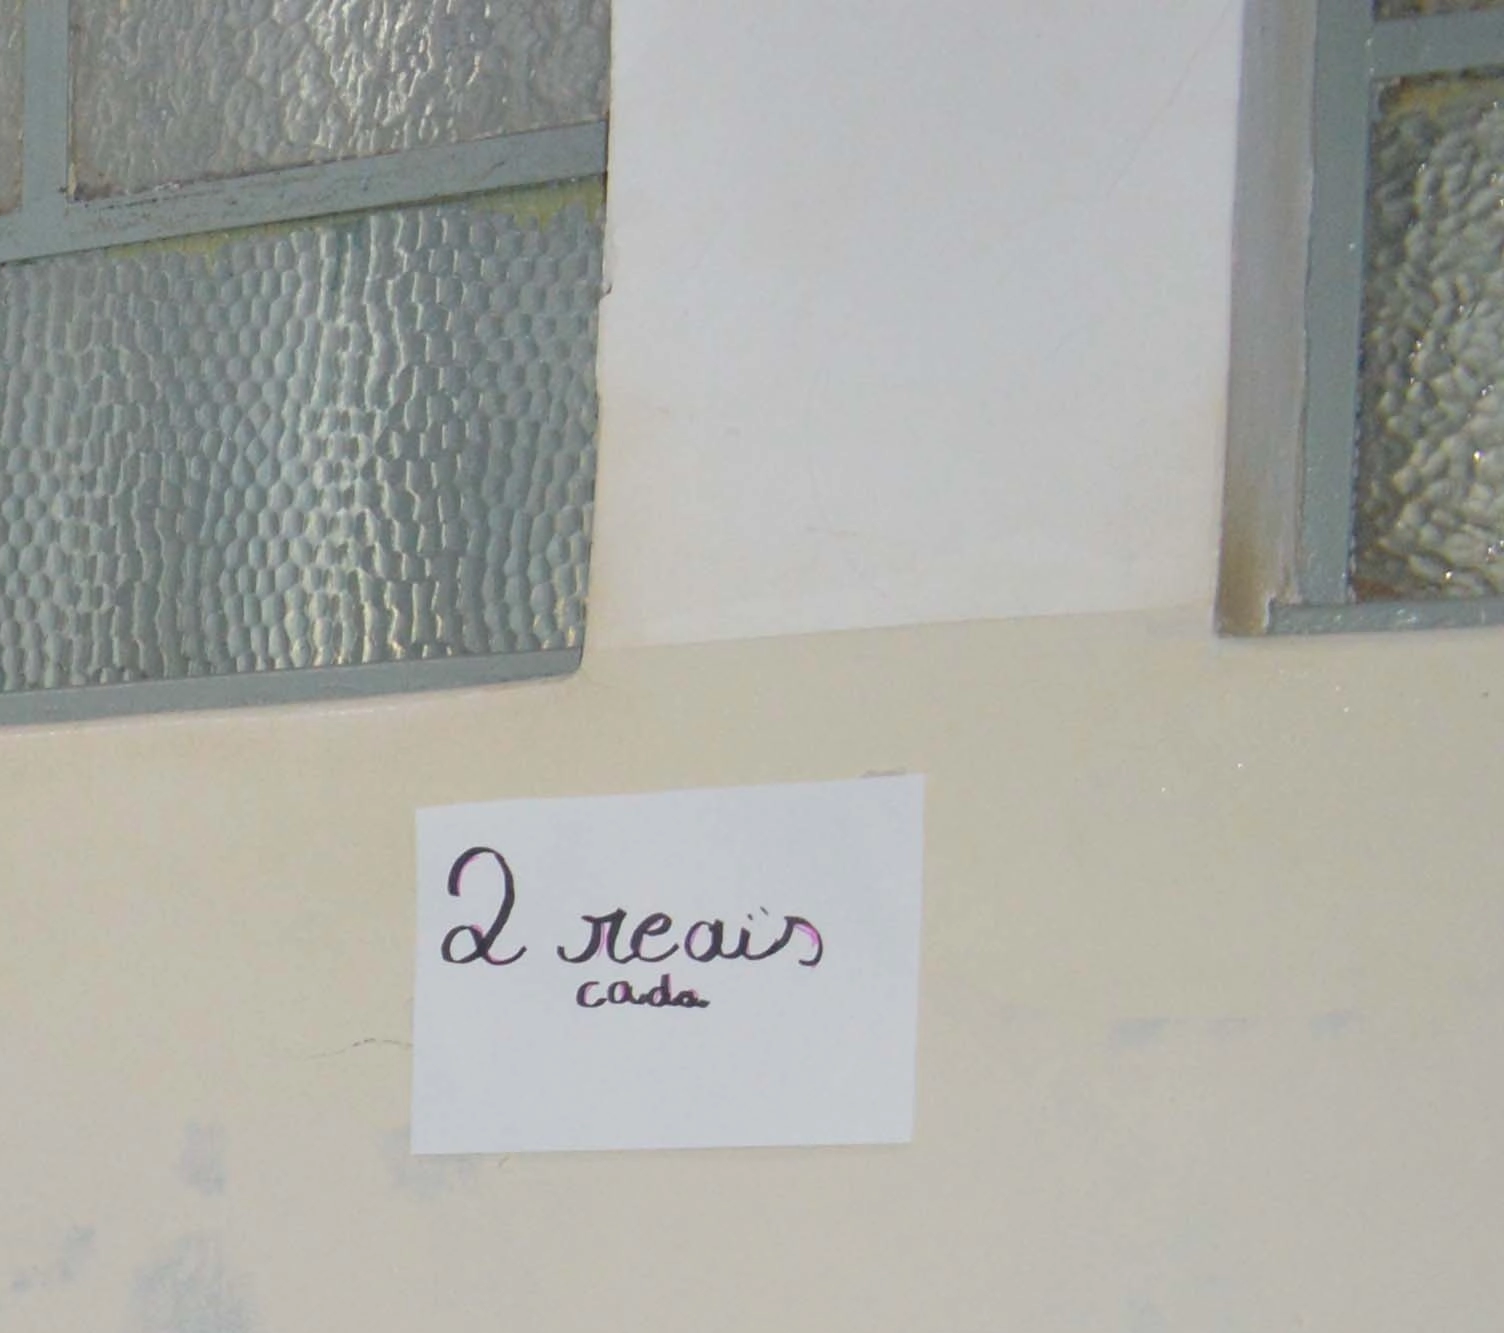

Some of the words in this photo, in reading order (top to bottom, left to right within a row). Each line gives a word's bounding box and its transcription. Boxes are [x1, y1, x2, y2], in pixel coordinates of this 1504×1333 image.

[441, 845, 528, 967] 2
[556, 905, 825, 968] reais
[576, 973, 711, 1009] cada
